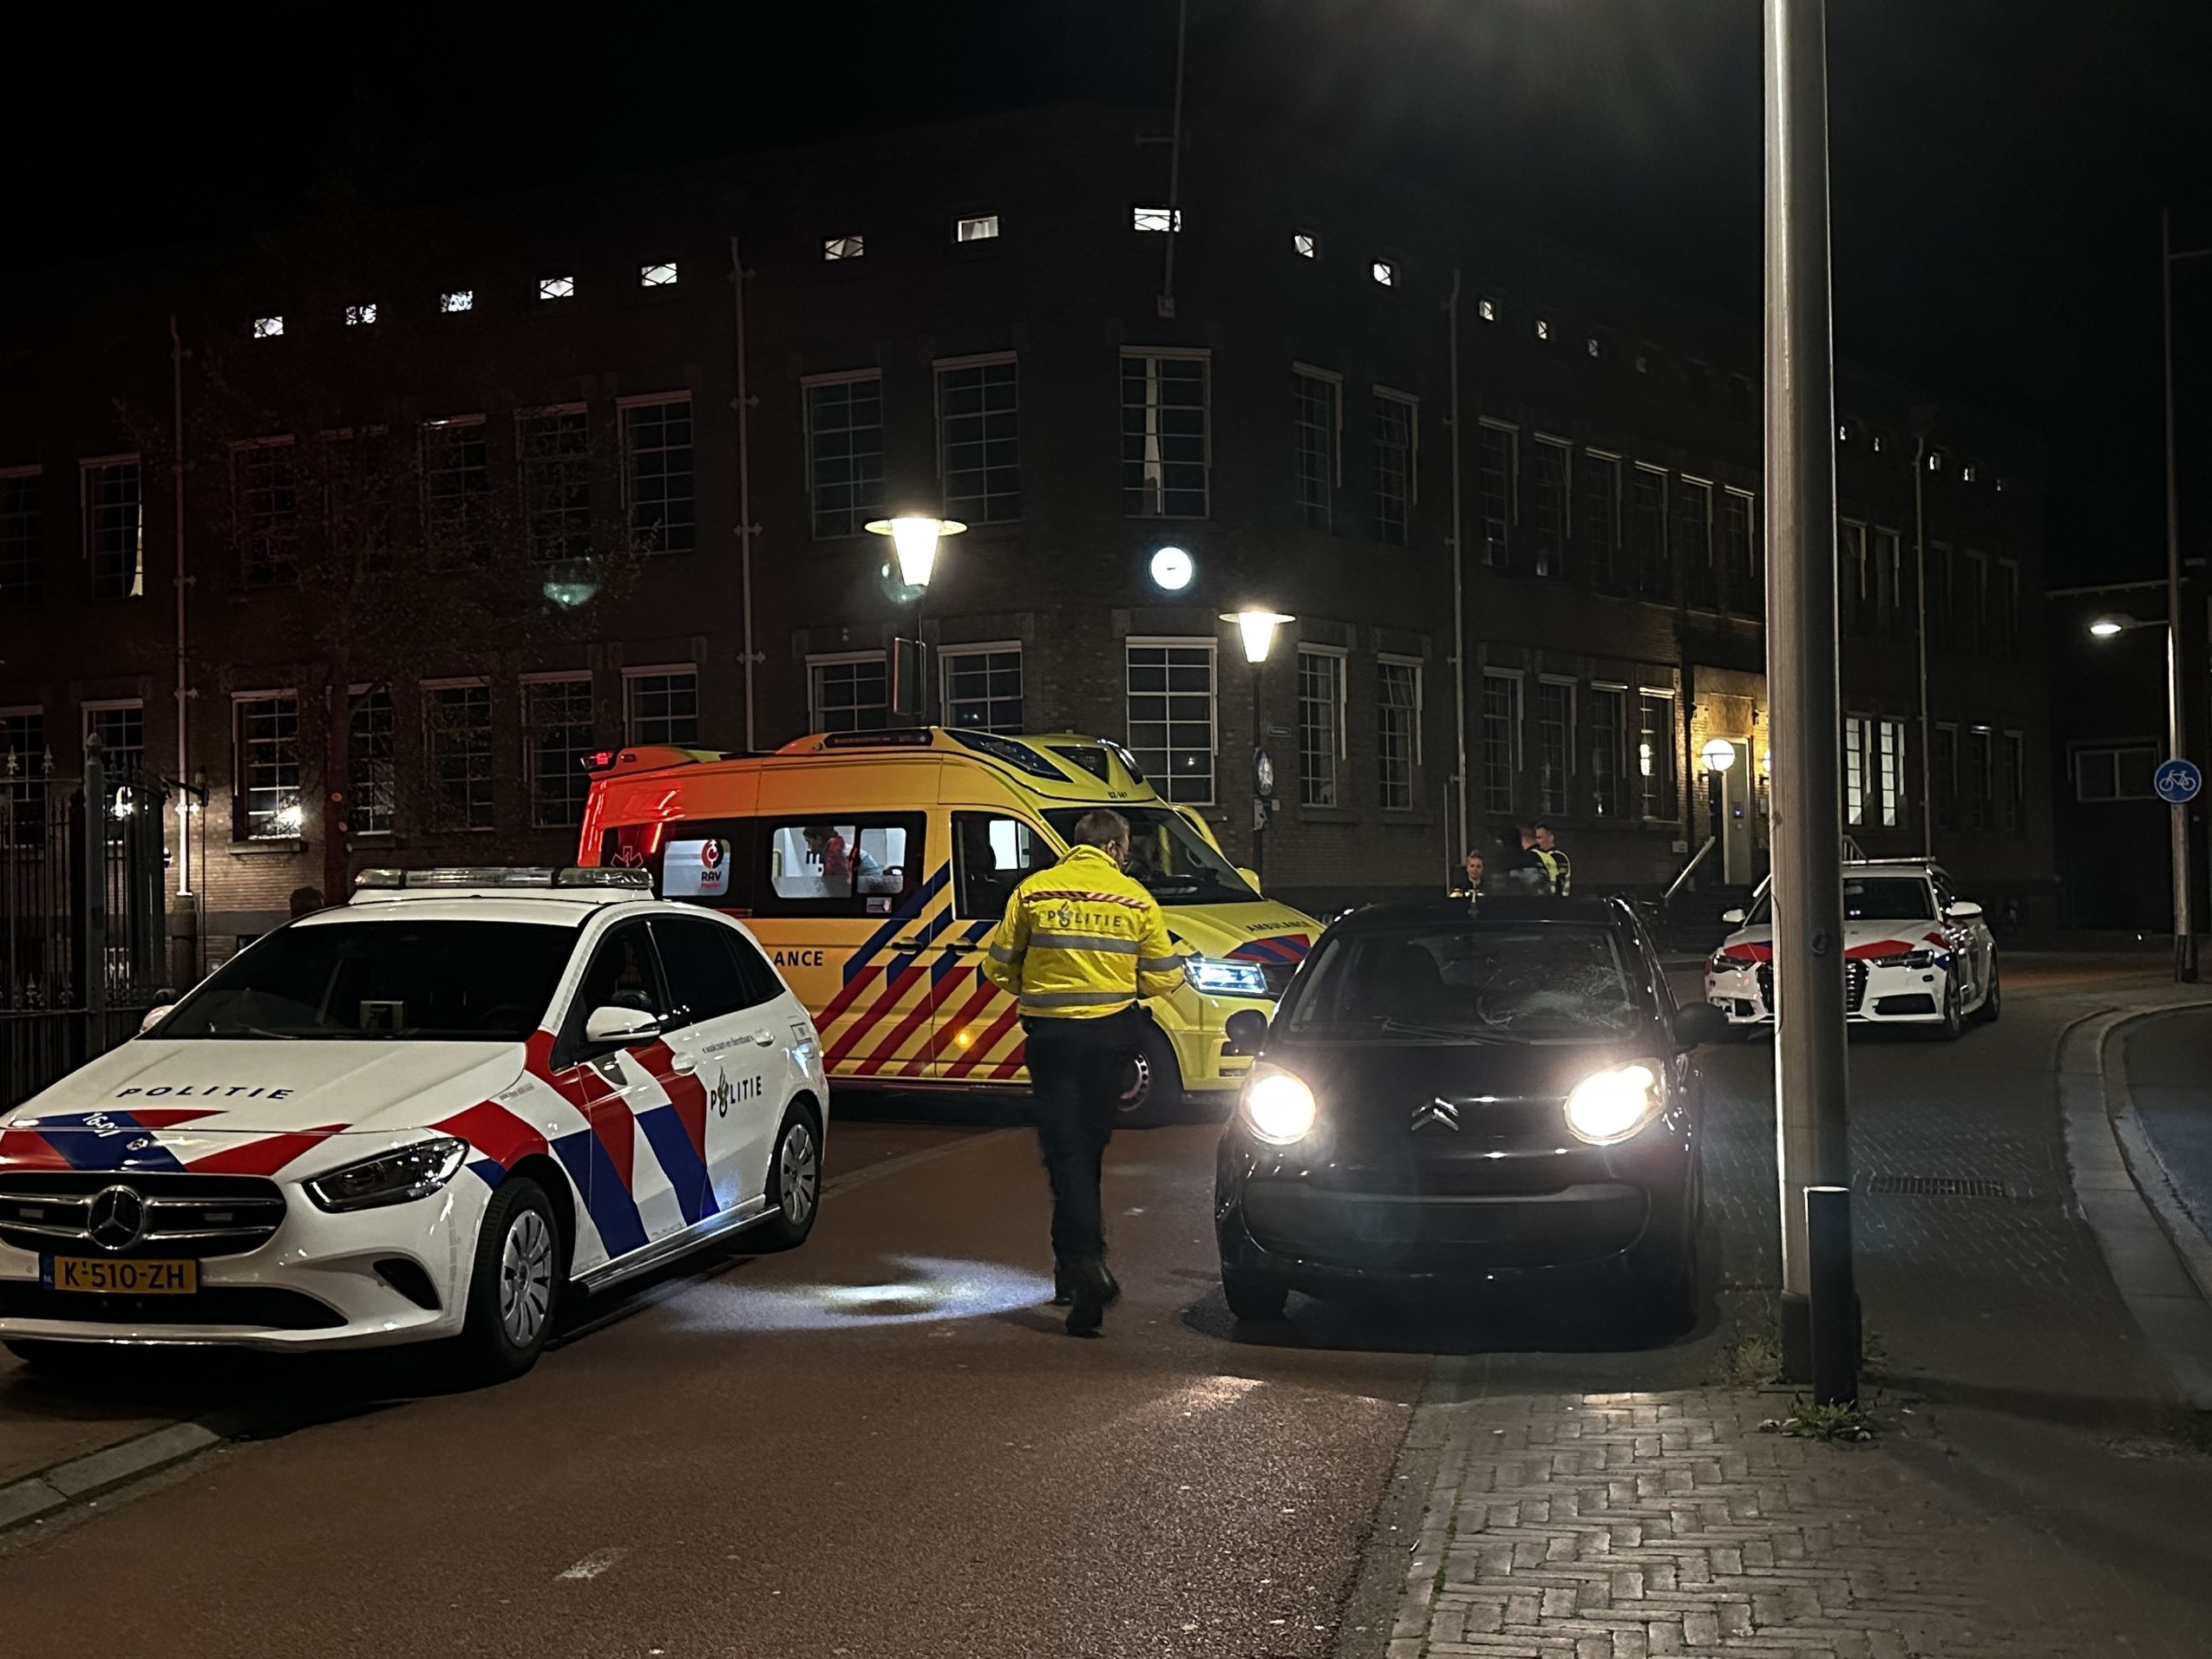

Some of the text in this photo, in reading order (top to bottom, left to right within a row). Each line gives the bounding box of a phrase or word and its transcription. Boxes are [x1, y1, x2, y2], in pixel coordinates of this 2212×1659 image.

[701, 871, 722, 881] RAV
[1047, 910, 1122, 928] POLITIE
[115, 1086, 295, 1101] POLITIE
[710, 1075, 762, 1118] POLITIE
[63, 1261, 185, 1290] K-510-ZH
